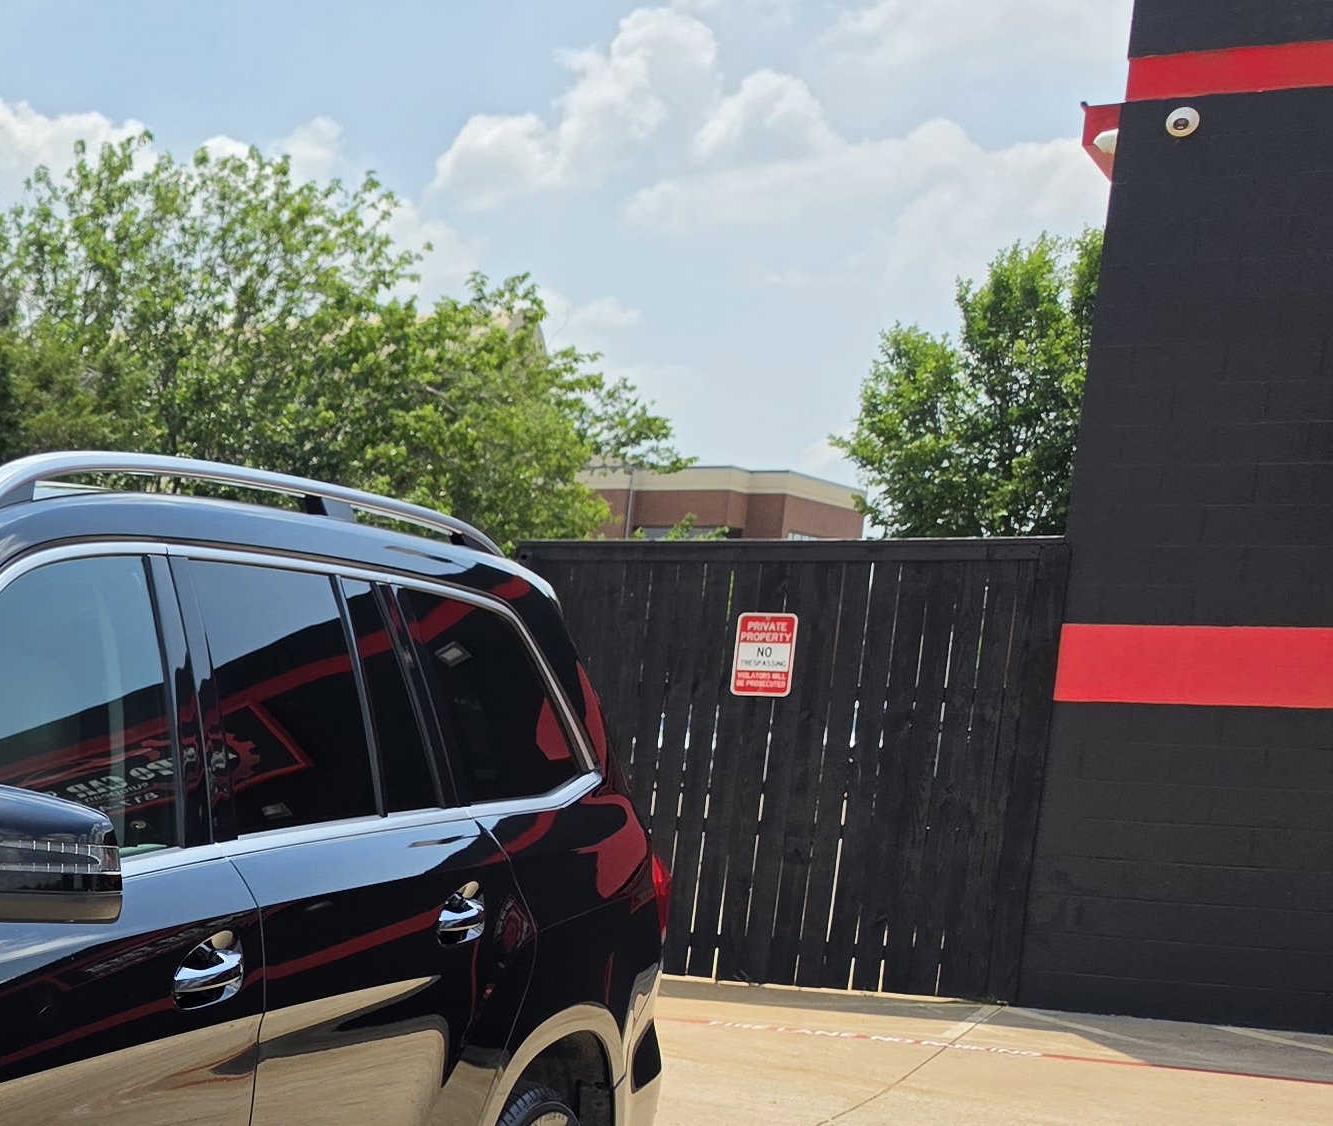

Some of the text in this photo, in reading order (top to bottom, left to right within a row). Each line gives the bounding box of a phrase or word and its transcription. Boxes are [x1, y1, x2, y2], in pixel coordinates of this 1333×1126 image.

[747, 621, 788, 632] PRIVATE
[740, 631, 792, 642] PROPERTY
[756, 646, 773, 658] NO
[737, 671, 787, 680] VIOLATORS WILL
[745, 680, 786, 688] PROSECUTED
